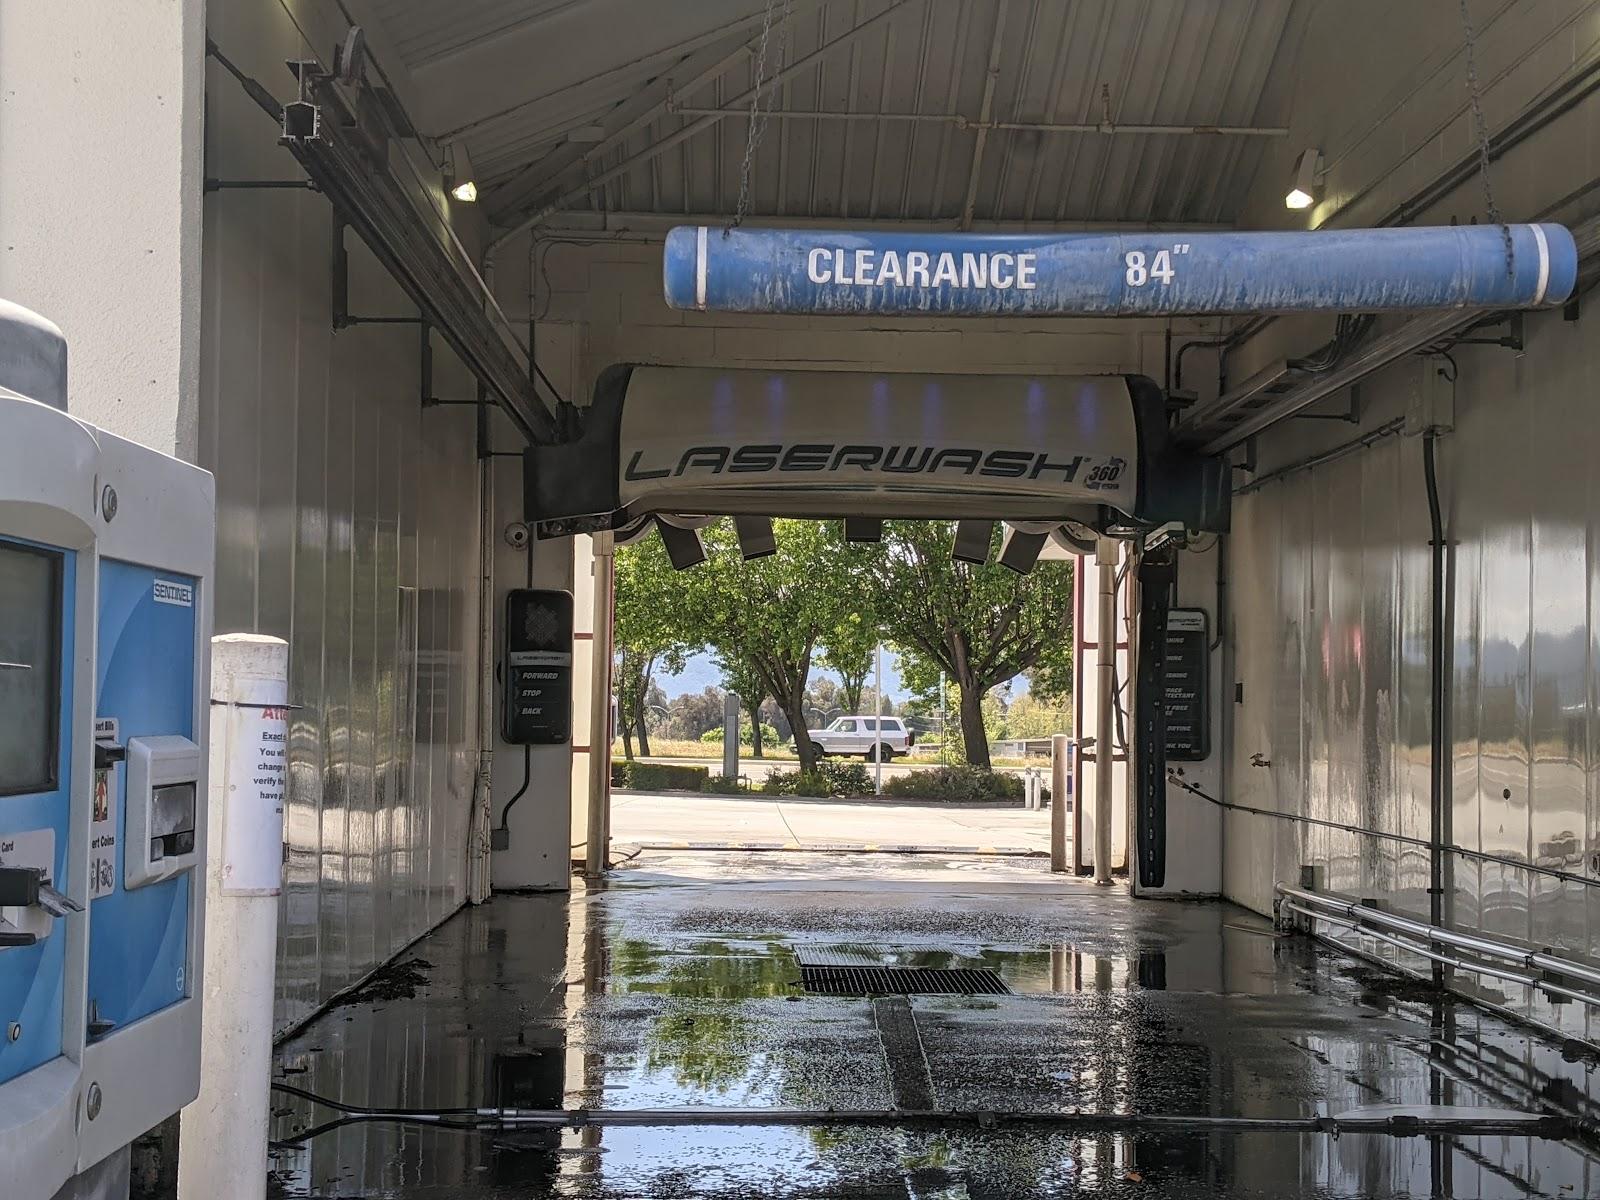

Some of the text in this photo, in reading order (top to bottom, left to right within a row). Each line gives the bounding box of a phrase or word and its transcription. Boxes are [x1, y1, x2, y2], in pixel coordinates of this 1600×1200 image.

[807, 244, 1190, 289] CLEARANCE 84"
[624, 444, 1120, 483] LASERWASH 360
[154, 583, 191, 603] SENTINEL
[522, 672, 559, 680] FORWARD
[521, 689, 542, 697] STOP
[521, 707, 543, 715] BACK
[262, 731, 282, 741] Exact
[259, 748, 275, 757] You
[253, 776, 277, 786] verify
[259, 791, 278, 799] have
[1, 840, 14, 853] Card
[100, 835, 115, 848] Coins
